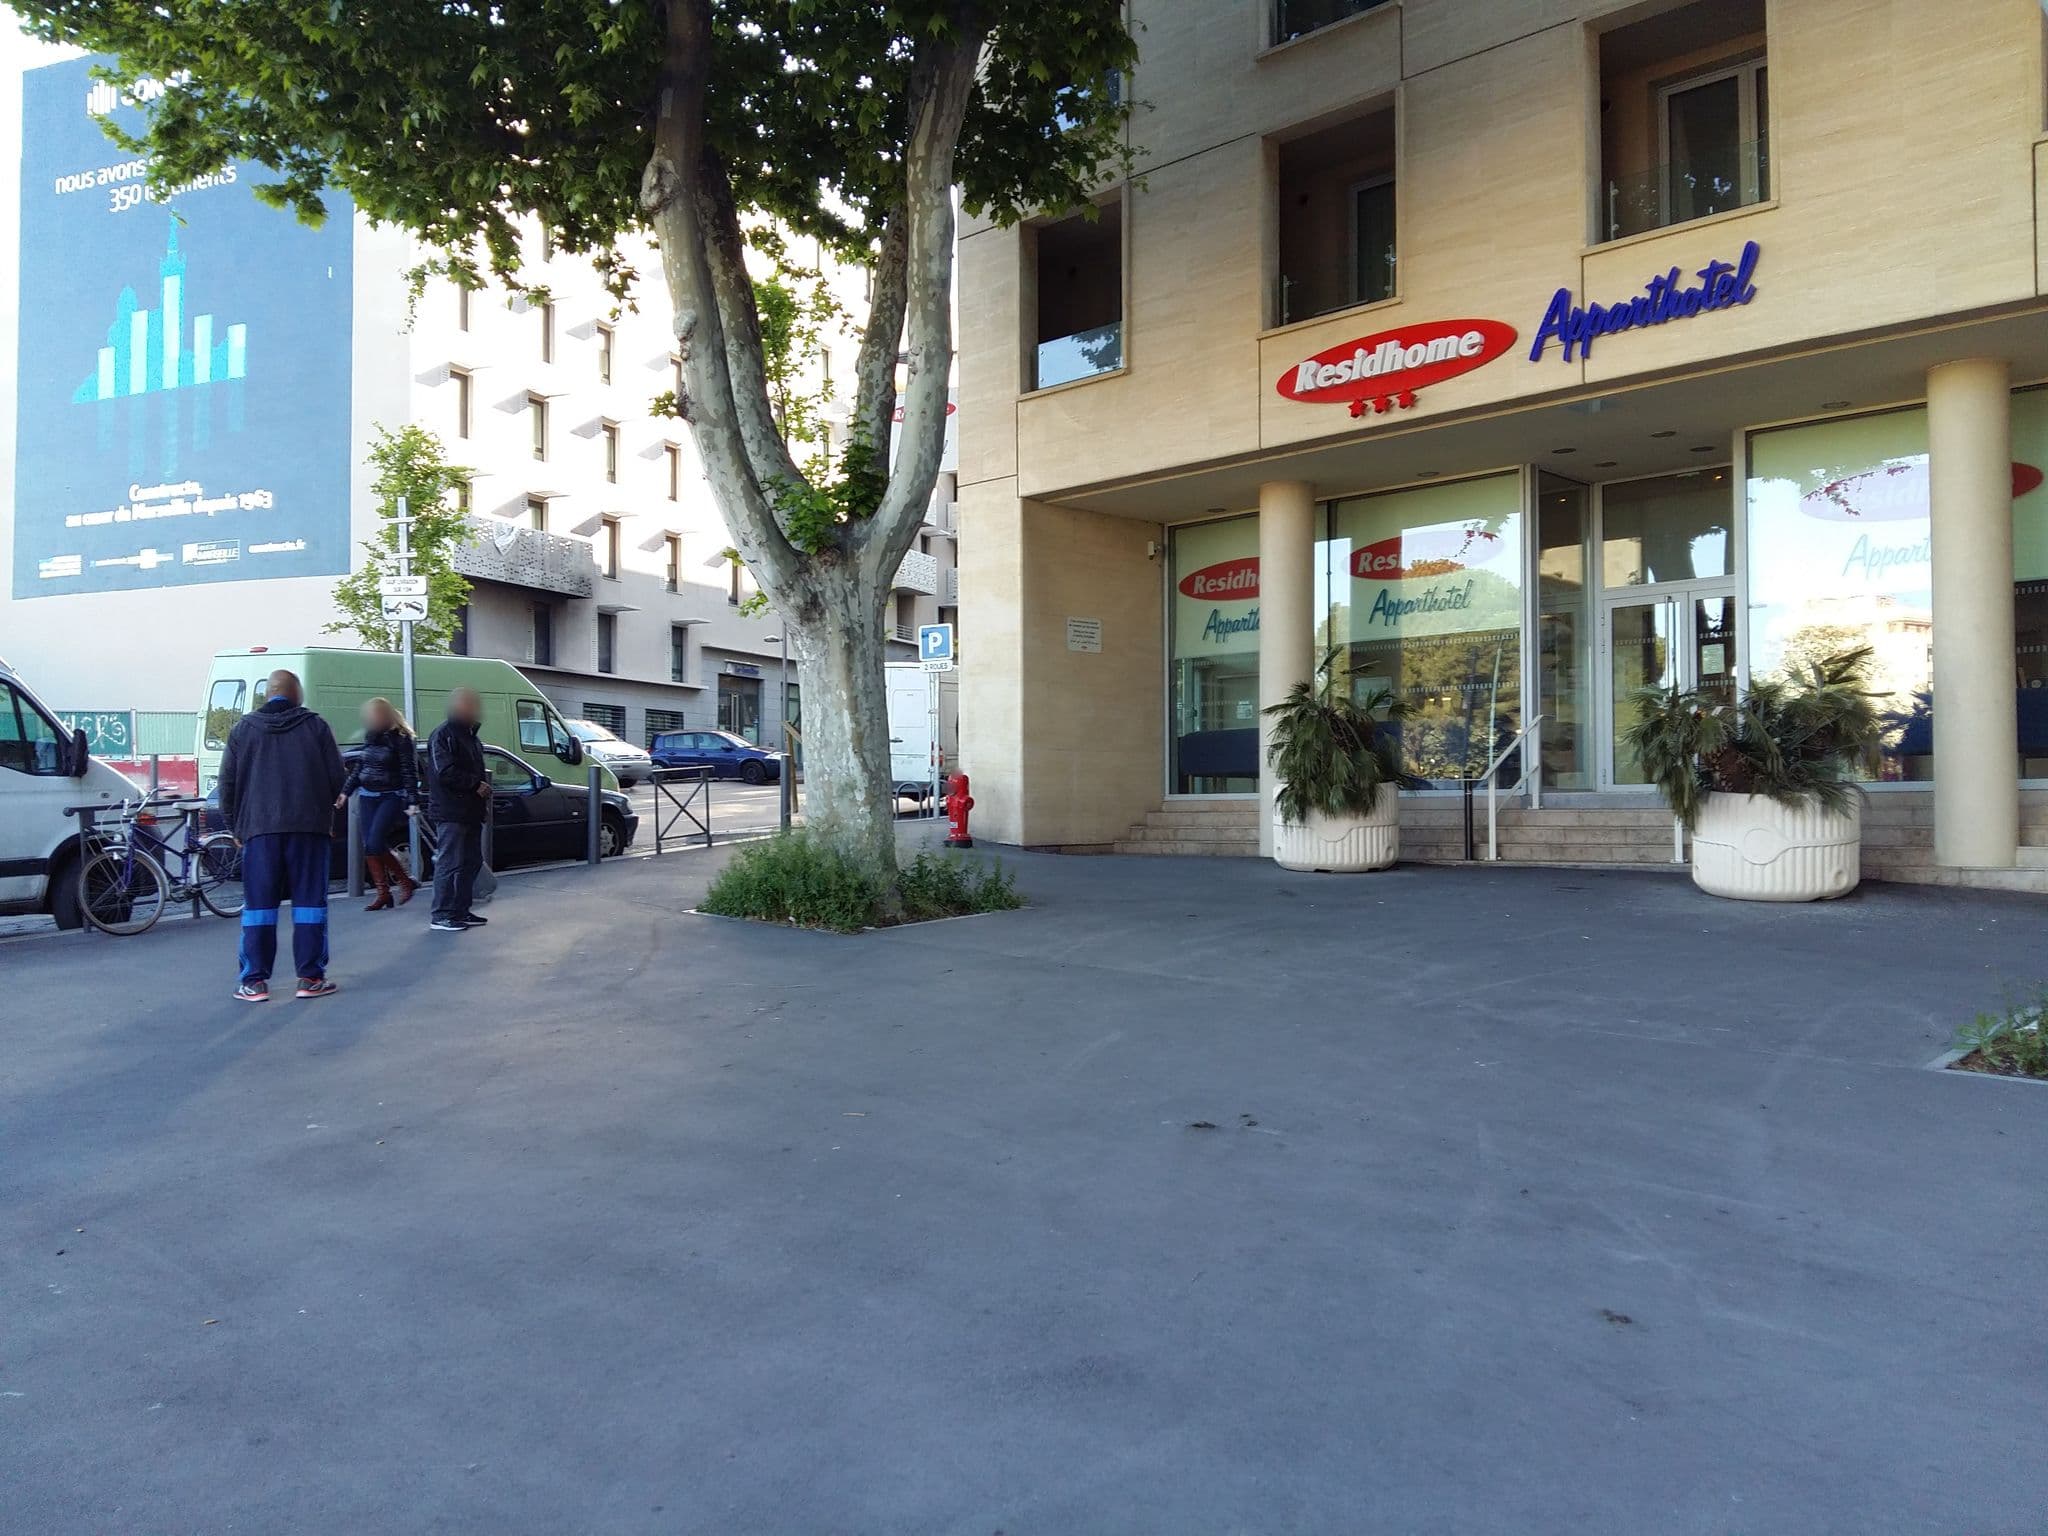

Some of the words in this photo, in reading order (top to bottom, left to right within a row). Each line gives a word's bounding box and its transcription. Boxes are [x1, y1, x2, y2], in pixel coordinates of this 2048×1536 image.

[56, 170, 95, 194] nous
[97, 159, 146, 185] avons
[109, 183, 141, 213] 350
[1529, 240, 1761, 363] Apparthotel
[1293, 330, 1484, 394] Residhome
[1193, 568, 1260, 595] Residh
[1368, 579, 1474, 627] Apparthotel
[928, 632, 943, 653] P
